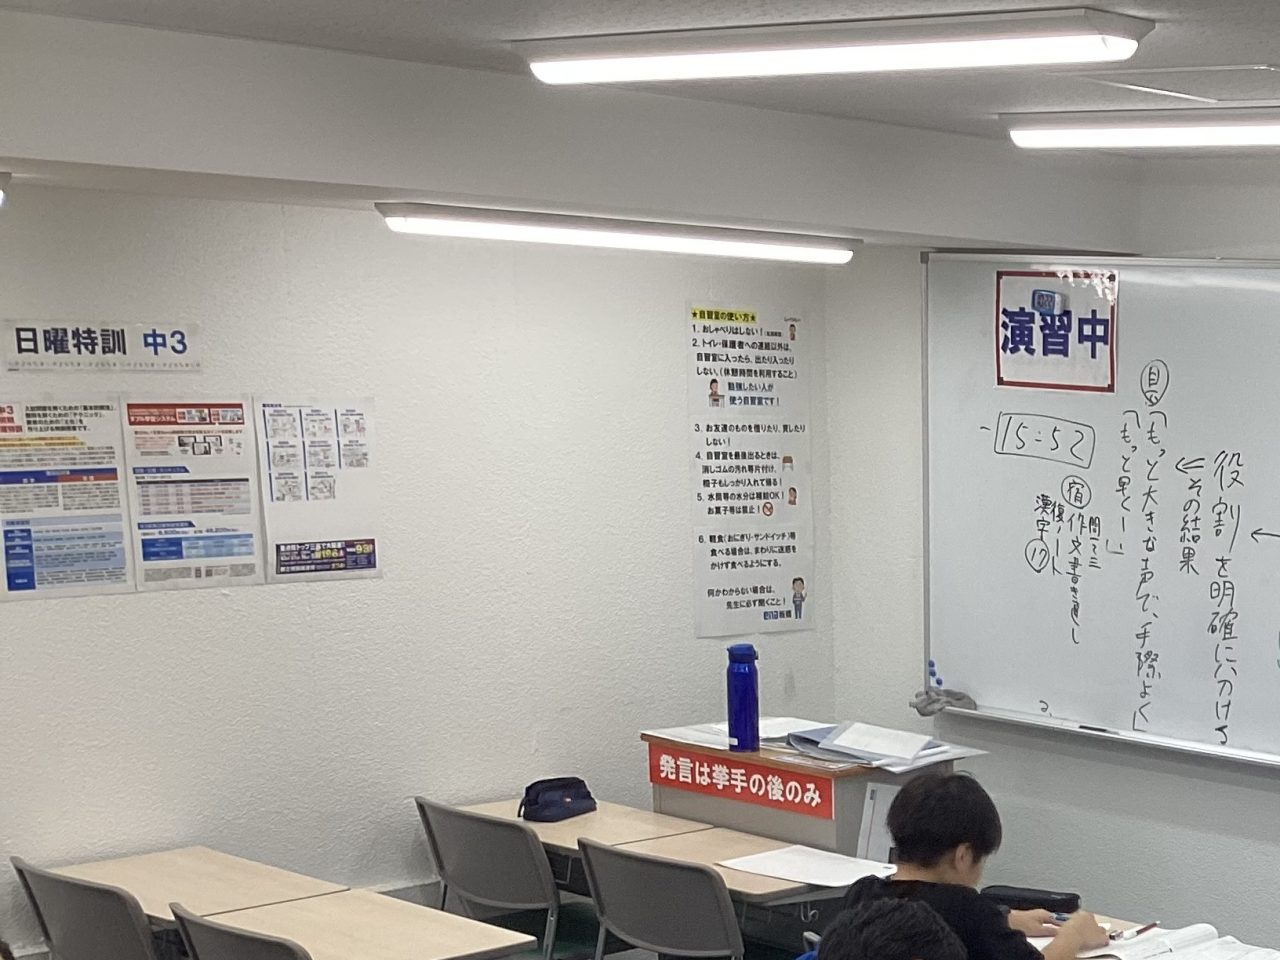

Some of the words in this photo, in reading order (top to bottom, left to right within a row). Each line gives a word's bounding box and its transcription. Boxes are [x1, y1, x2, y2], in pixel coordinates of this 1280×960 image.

[15, 327, 127, 355] 日曜特訓
[143, 328, 188, 355] 中3
[1001, 306, 1110, 359] 演習中
[1180, 477, 1203, 576] その結果
[659, 754, 821, 808] 発言は挙手の後のみ
